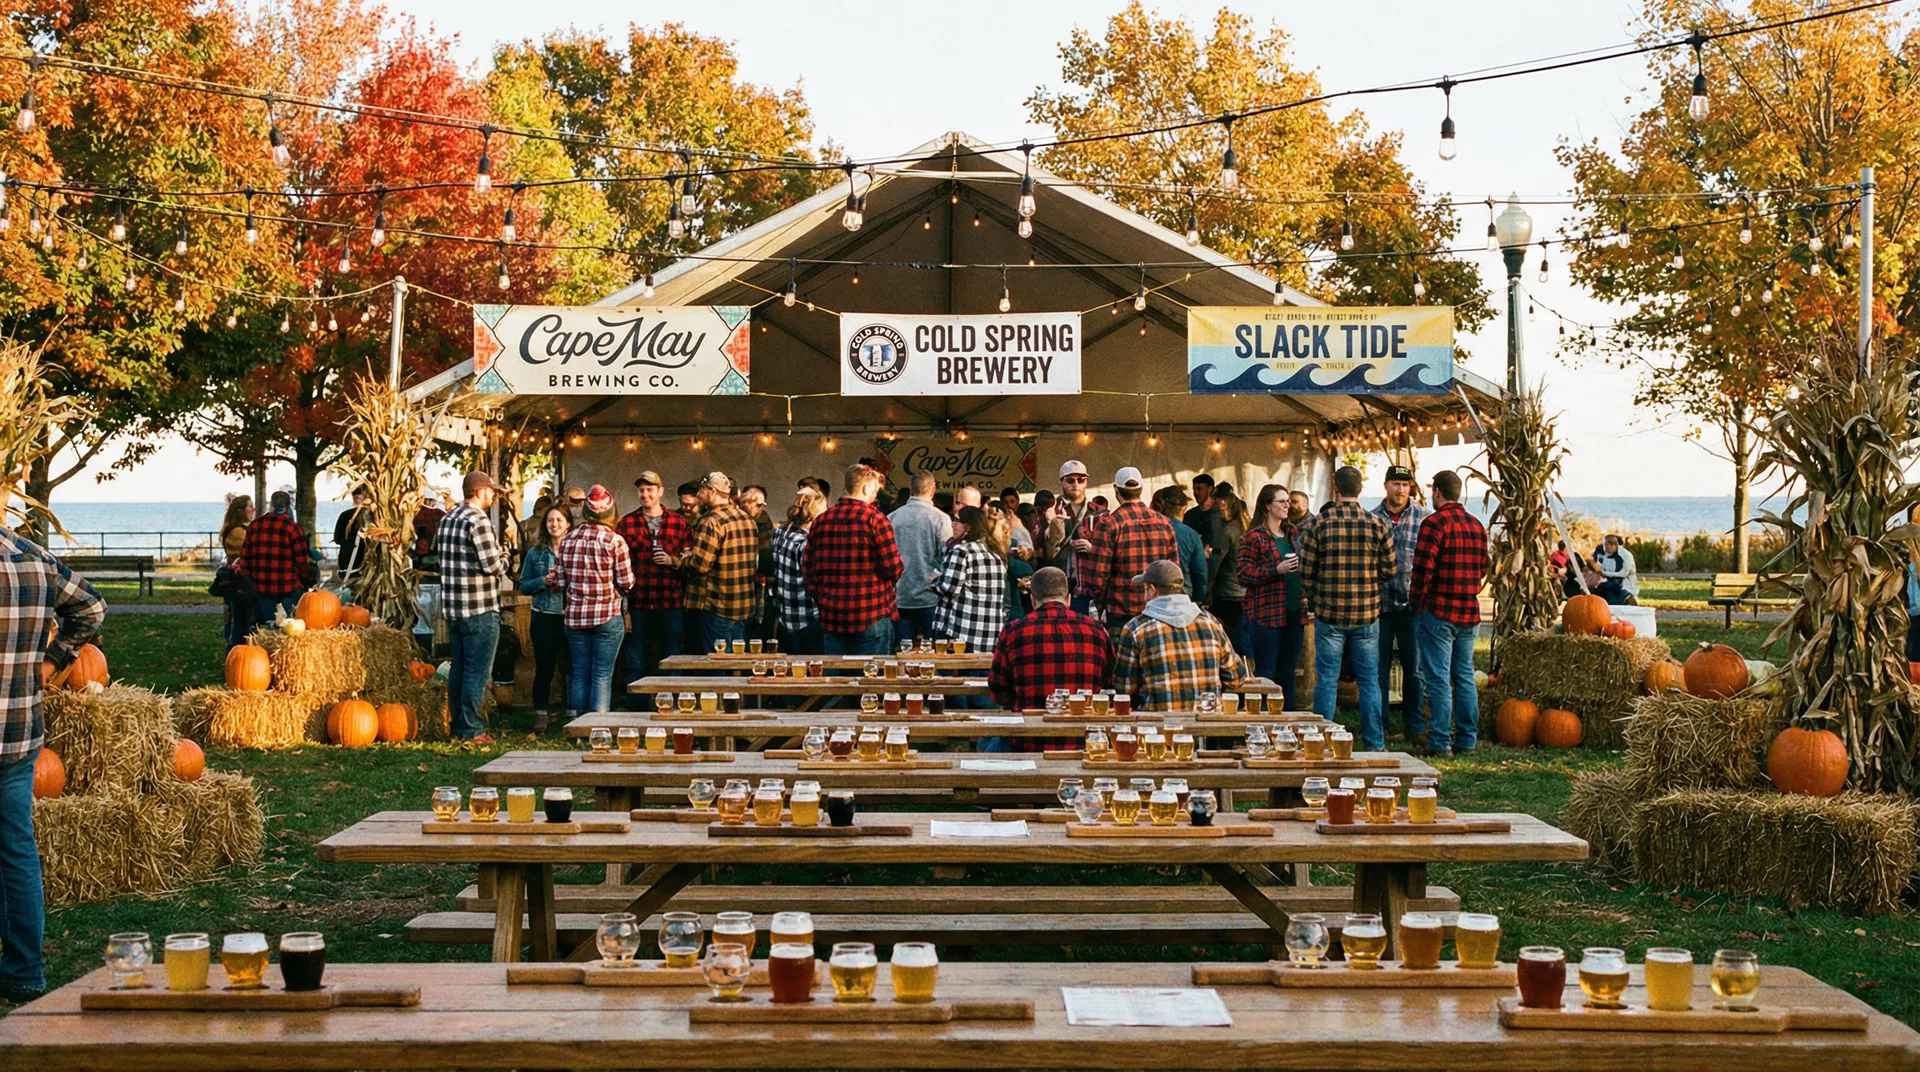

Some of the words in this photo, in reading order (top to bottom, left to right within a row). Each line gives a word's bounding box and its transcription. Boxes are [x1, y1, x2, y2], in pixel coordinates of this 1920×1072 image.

[519, 313, 614, 365] Cape
[597, 315, 707, 369] May
[851, 328, 872, 349] COLD
[915, 324, 976, 353] COLD
[984, 324, 1073, 353] SPRING
[1234, 323, 1330, 359] SLACK
[1340, 324, 1407, 359] TIDE
[549, 374, 640, 387] BREWING
[648, 374, 679, 387] CO.
[937, 355, 1053, 385] BREWERY
[902, 445, 957, 476] Cape
[945, 446, 1010, 477] May
[936, 480, 973, 489] EWIN
